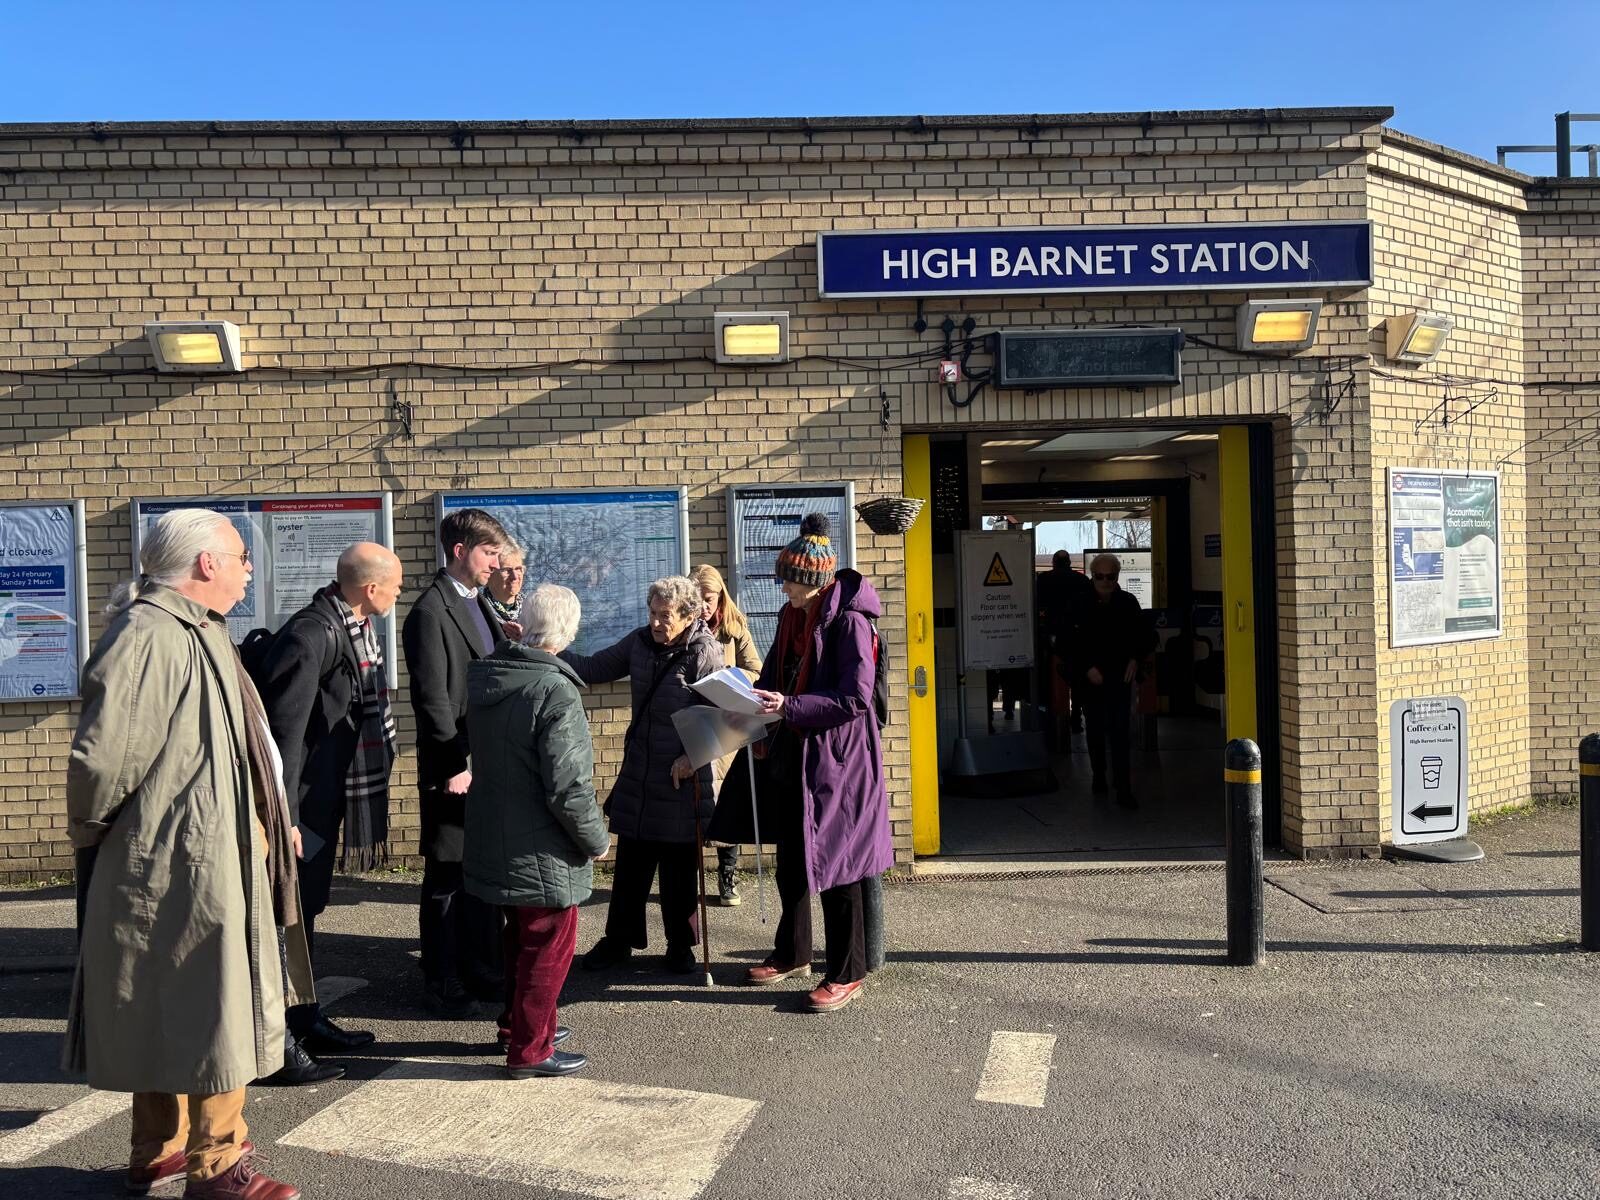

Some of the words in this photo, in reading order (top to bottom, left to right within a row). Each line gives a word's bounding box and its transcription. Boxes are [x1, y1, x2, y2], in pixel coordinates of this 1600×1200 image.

[883, 247, 977, 280] HIGH
[990, 243, 1138, 278] BARNET
[1150, 239, 1310, 275] STATION
[1085, 358, 1107, 372] not
[1447, 507, 1485, 518] Accountancy
[277, 523, 304, 533] oyster
[1446, 518, 1460, 527] that
[1461, 518, 1474, 527] isn't
[1474, 518, 1492, 529] taxing.
[9, 547, 54, 557] closures
[22, 571, 52, 579] February
[1, 579, 26, 587] Sunday
[985, 593, 1011, 601] Caution
[980, 603, 996, 611] Floor
[1406, 724, 1432, 732] Coffee
[1438, 722, 1457, 731] Cal's
